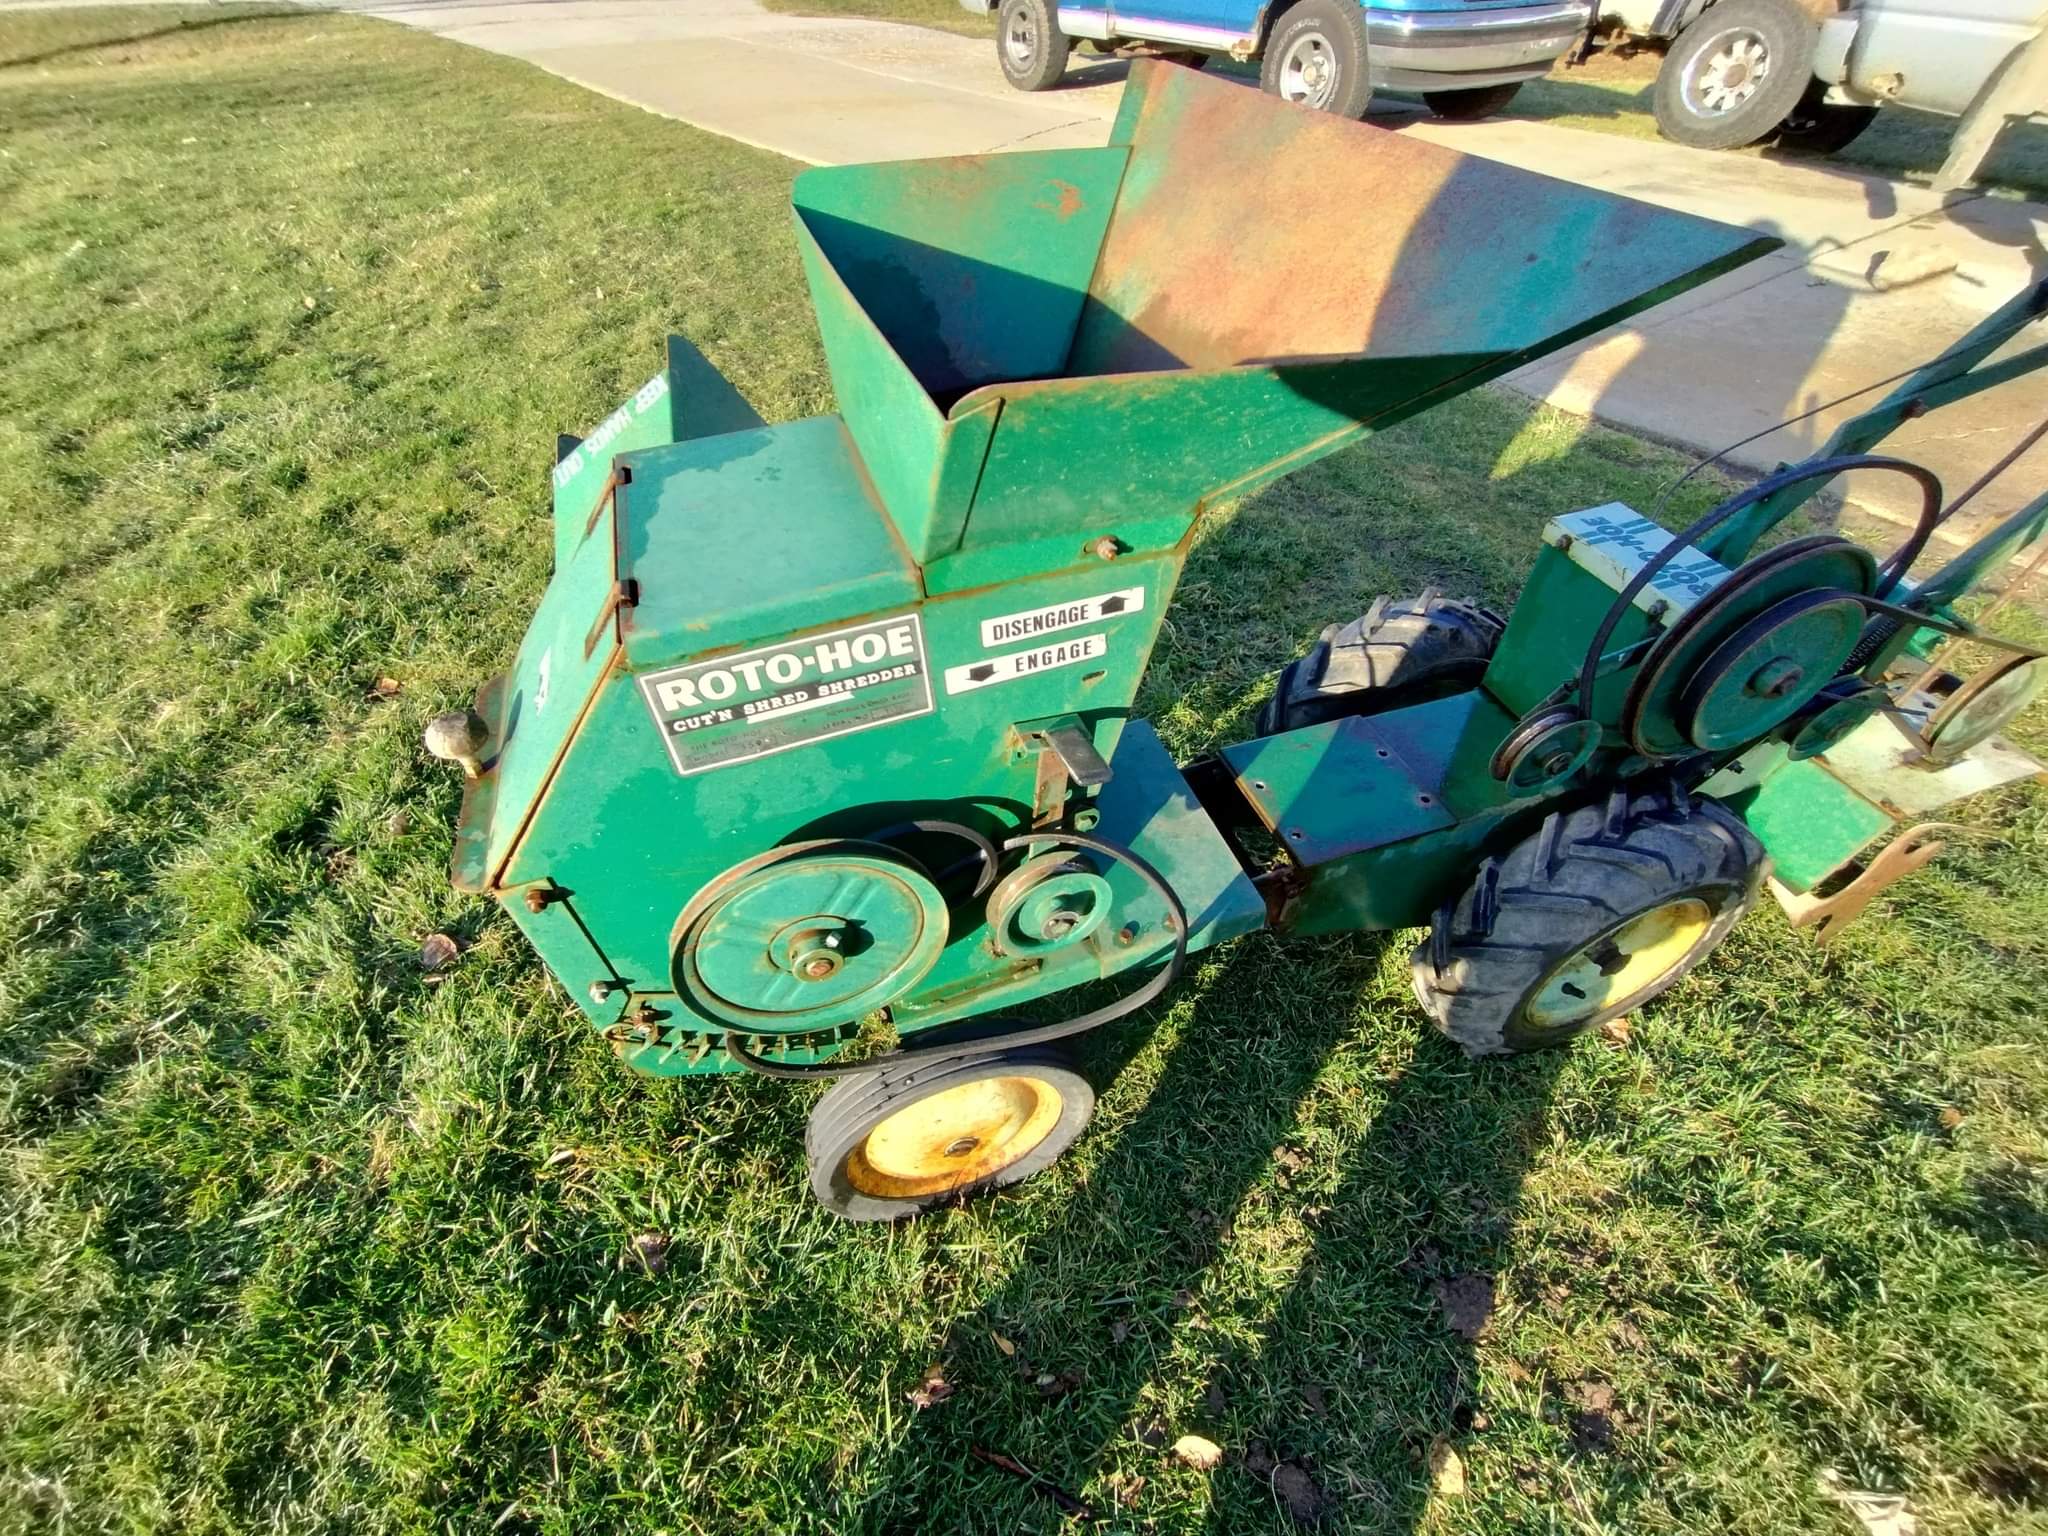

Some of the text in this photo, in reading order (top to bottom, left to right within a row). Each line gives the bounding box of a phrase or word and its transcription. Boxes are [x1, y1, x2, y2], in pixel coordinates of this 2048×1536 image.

[993, 603, 1089, 641] DISENGAGE
[655, 625, 914, 712] ROTO-HOE
[1015, 639, 1092, 673] ENGAGE
[672, 708, 734, 732] CUT'N
[743, 691, 809, 716] SHRED
[817, 664, 917, 697] SHREDDER
